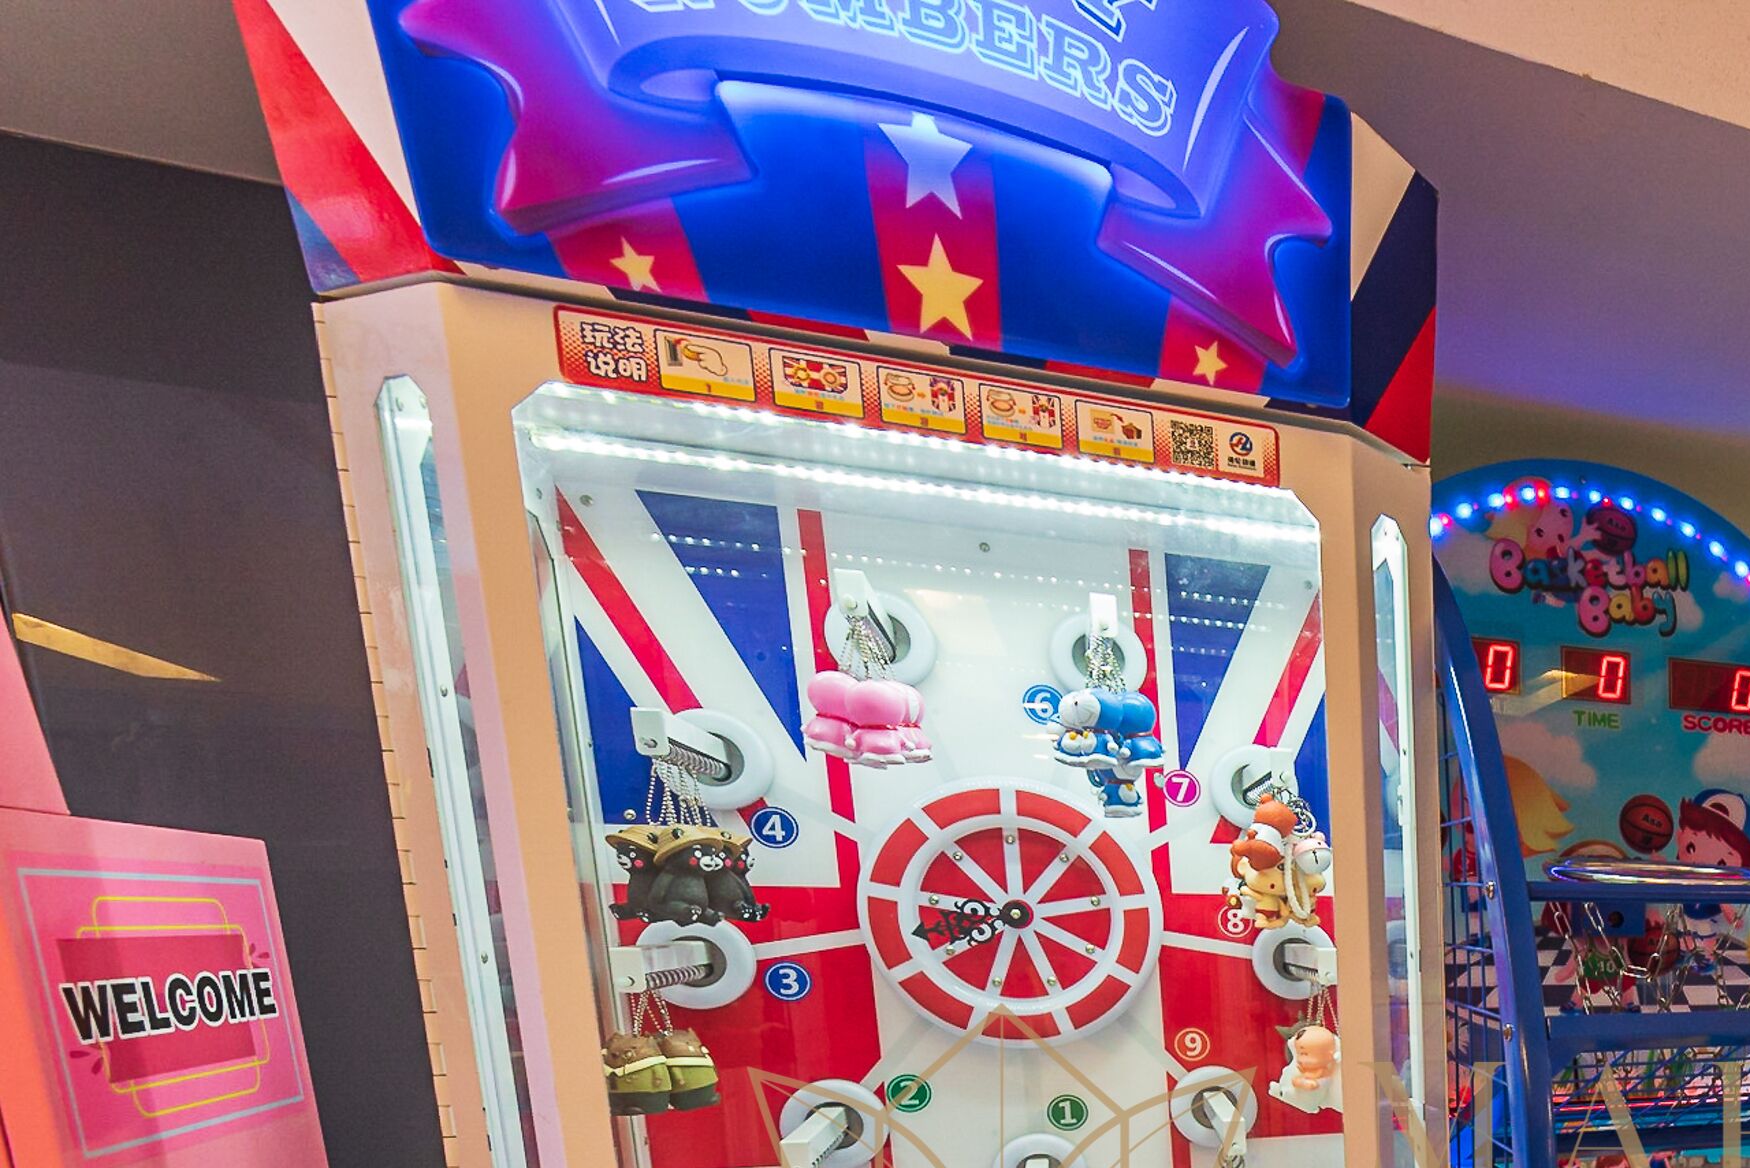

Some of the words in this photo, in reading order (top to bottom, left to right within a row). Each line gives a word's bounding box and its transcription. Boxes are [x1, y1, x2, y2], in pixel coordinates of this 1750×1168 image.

[580, 320, 643, 353] 玩法
[586, 351, 648, 382] 说明
[1489, 536, 1689, 593] Basketball
[1577, 585, 1677, 637] Baby
[1484, 644, 1515, 690] 0
[1597, 655, 1627, 699] 0
[1573, 710, 1620, 729] TIME
[61, 968, 278, 1044] WELCOME
